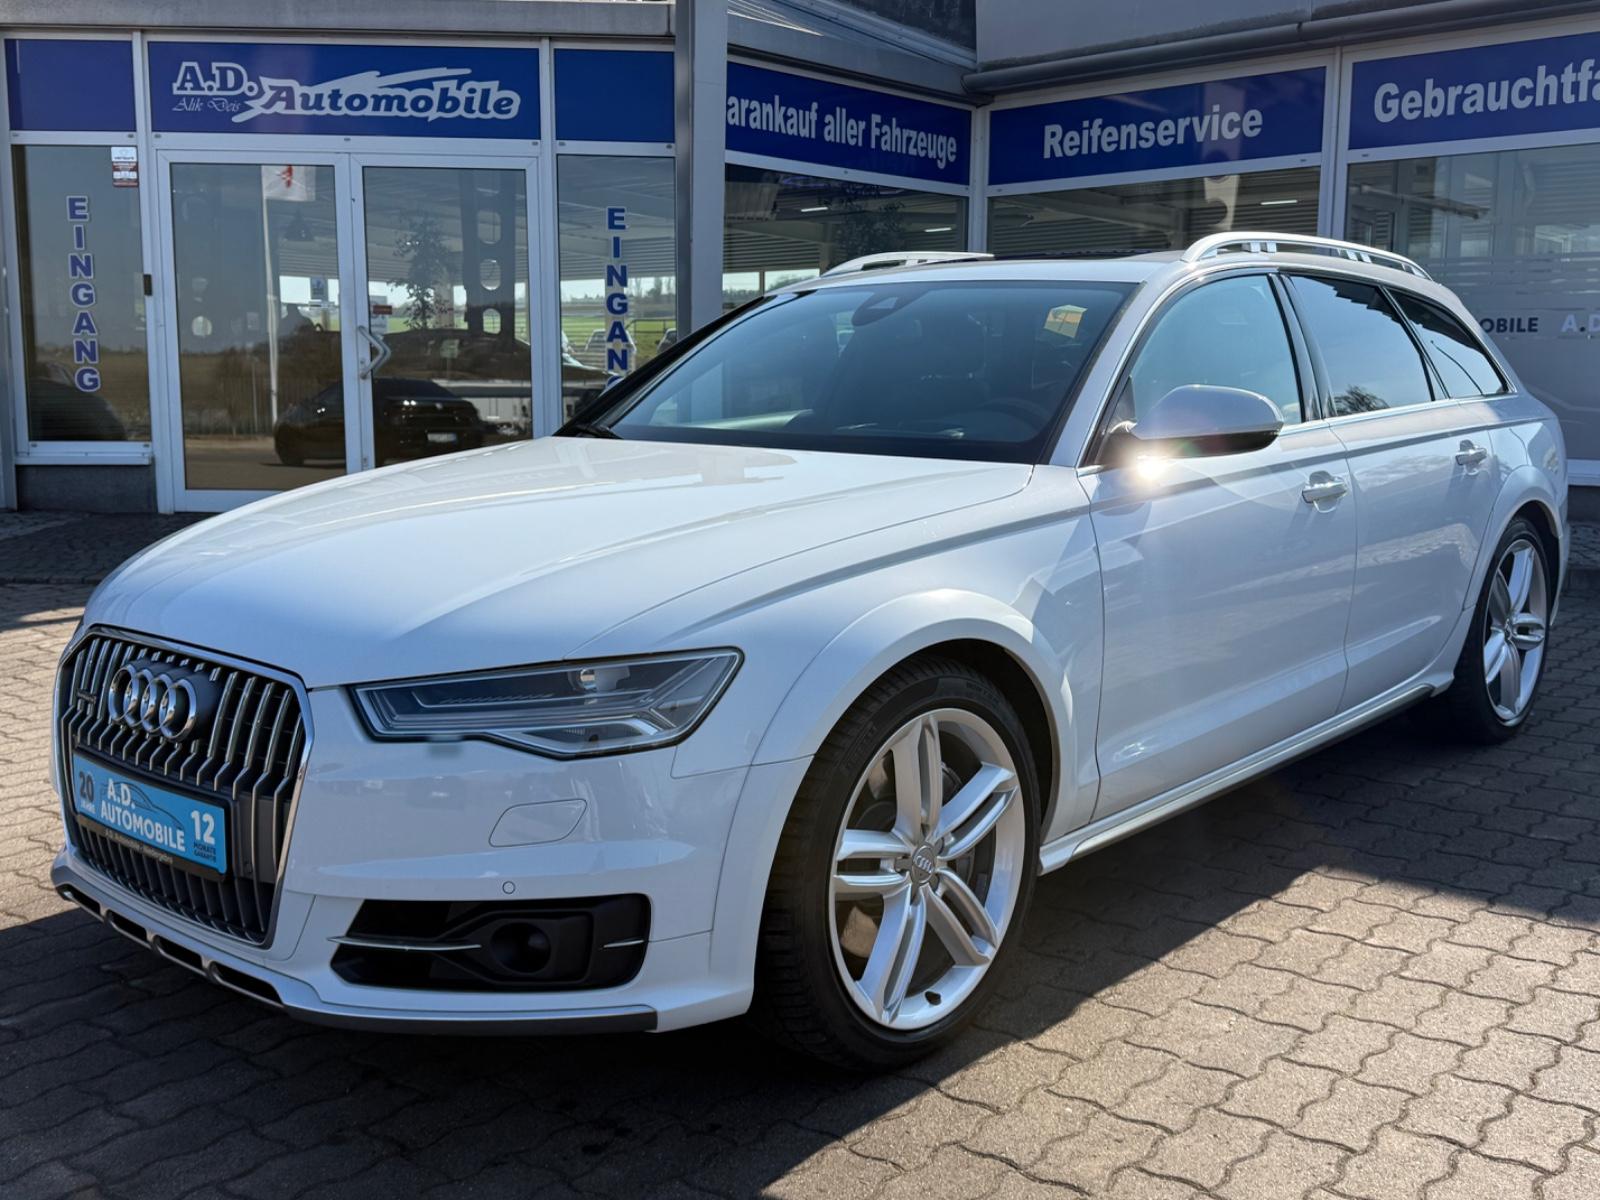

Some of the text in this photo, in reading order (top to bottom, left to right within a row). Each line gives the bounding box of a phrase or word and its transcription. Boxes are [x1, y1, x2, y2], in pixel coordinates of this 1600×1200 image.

[172, 61, 522, 122] A.D. Automobile
[823, 106, 867, 147] aller
[870, 113, 958, 170] Fahrzeuge
[1042, 104, 1264, 159] Reifenservice
[66, 195, 101, 393] EINGANG
[79, 771, 95, 803] 20
[107, 778, 136, 809] A.D.
[101, 801, 186, 852] AUTOMOBILE
[191, 810, 216, 846] 12
